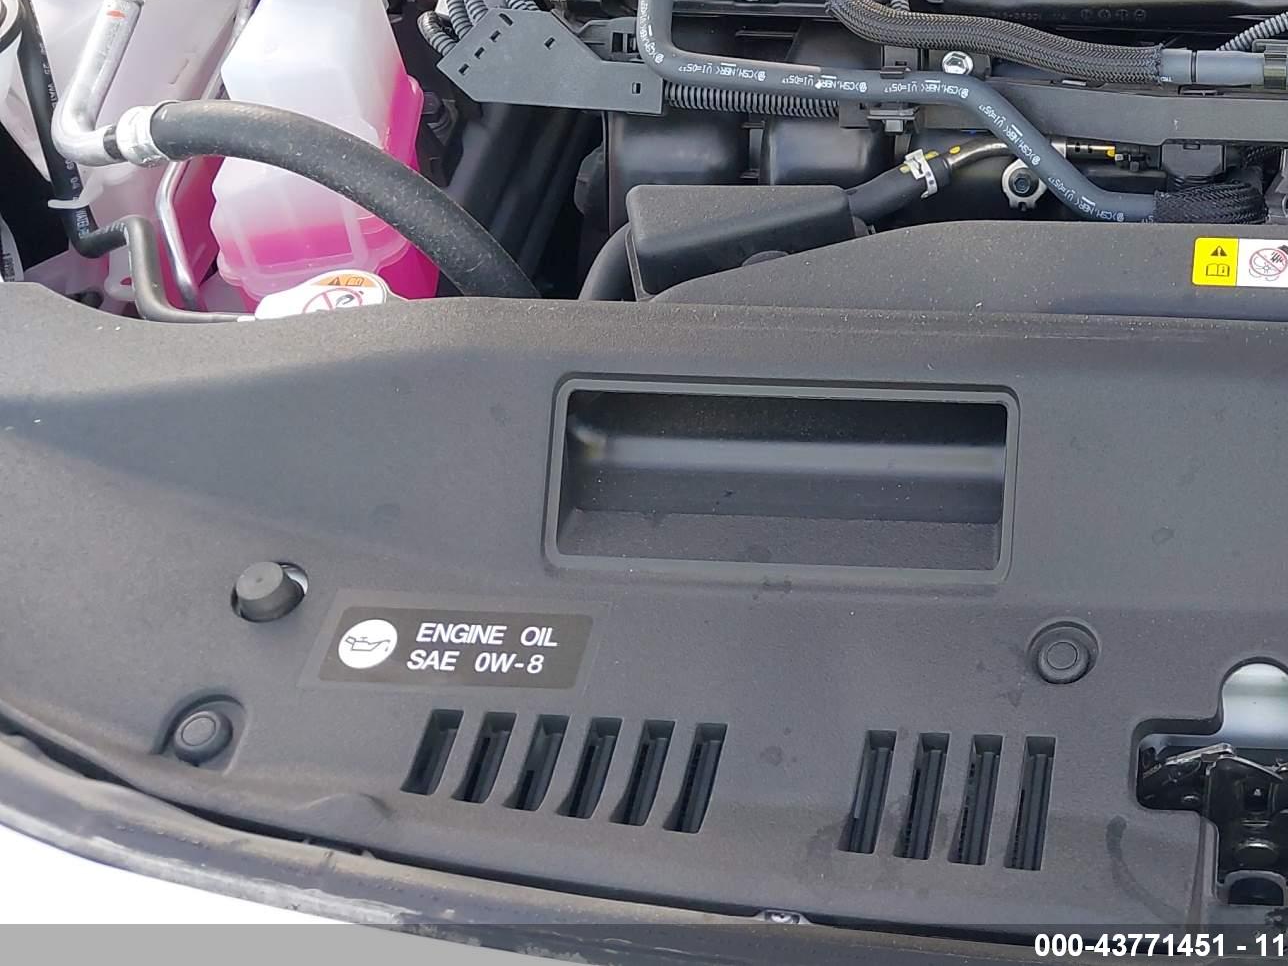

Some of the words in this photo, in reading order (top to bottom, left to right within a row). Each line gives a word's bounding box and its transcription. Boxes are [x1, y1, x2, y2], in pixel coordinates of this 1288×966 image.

[416, 622, 507, 645] ENGINE
[520, 626, 559, 647] OIL
[406, 649, 460, 672] SAE
[474, 652, 545, 674] 0W-8
